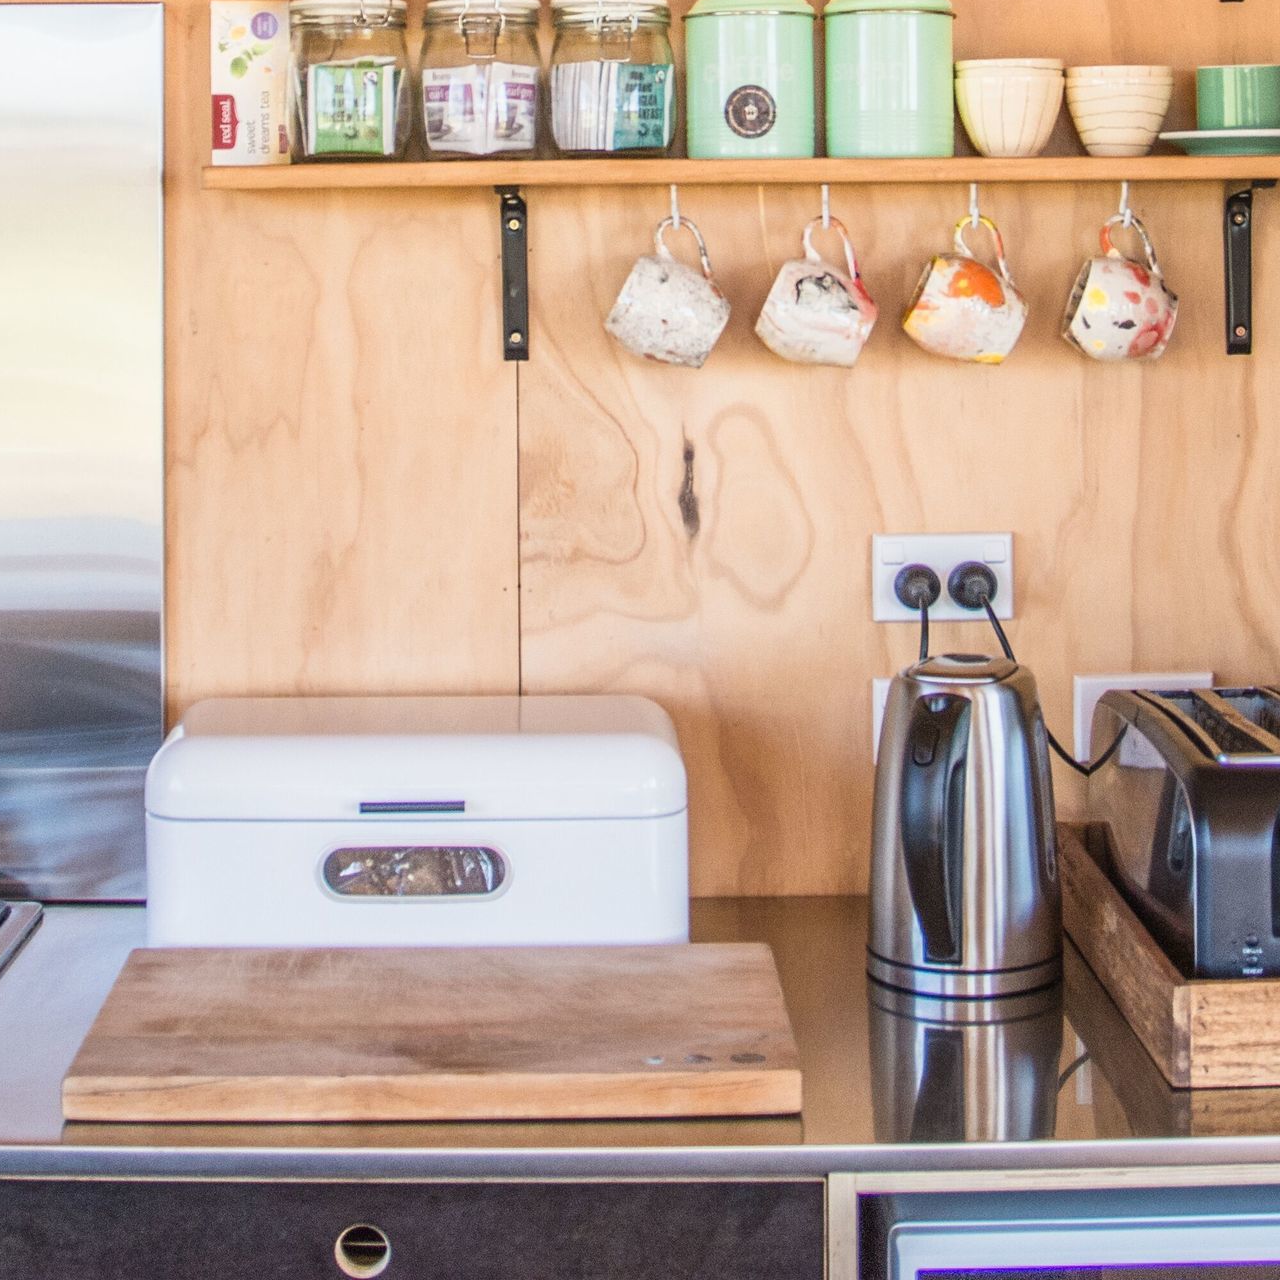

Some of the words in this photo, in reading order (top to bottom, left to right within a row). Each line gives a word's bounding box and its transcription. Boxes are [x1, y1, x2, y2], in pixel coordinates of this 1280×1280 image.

[219, 99, 232, 123] seal
[259, 90, 271, 110] tea
[219, 123, 232, 145] red
[245, 120, 257, 155] sweet
[258, 112, 271, 155] dreams
